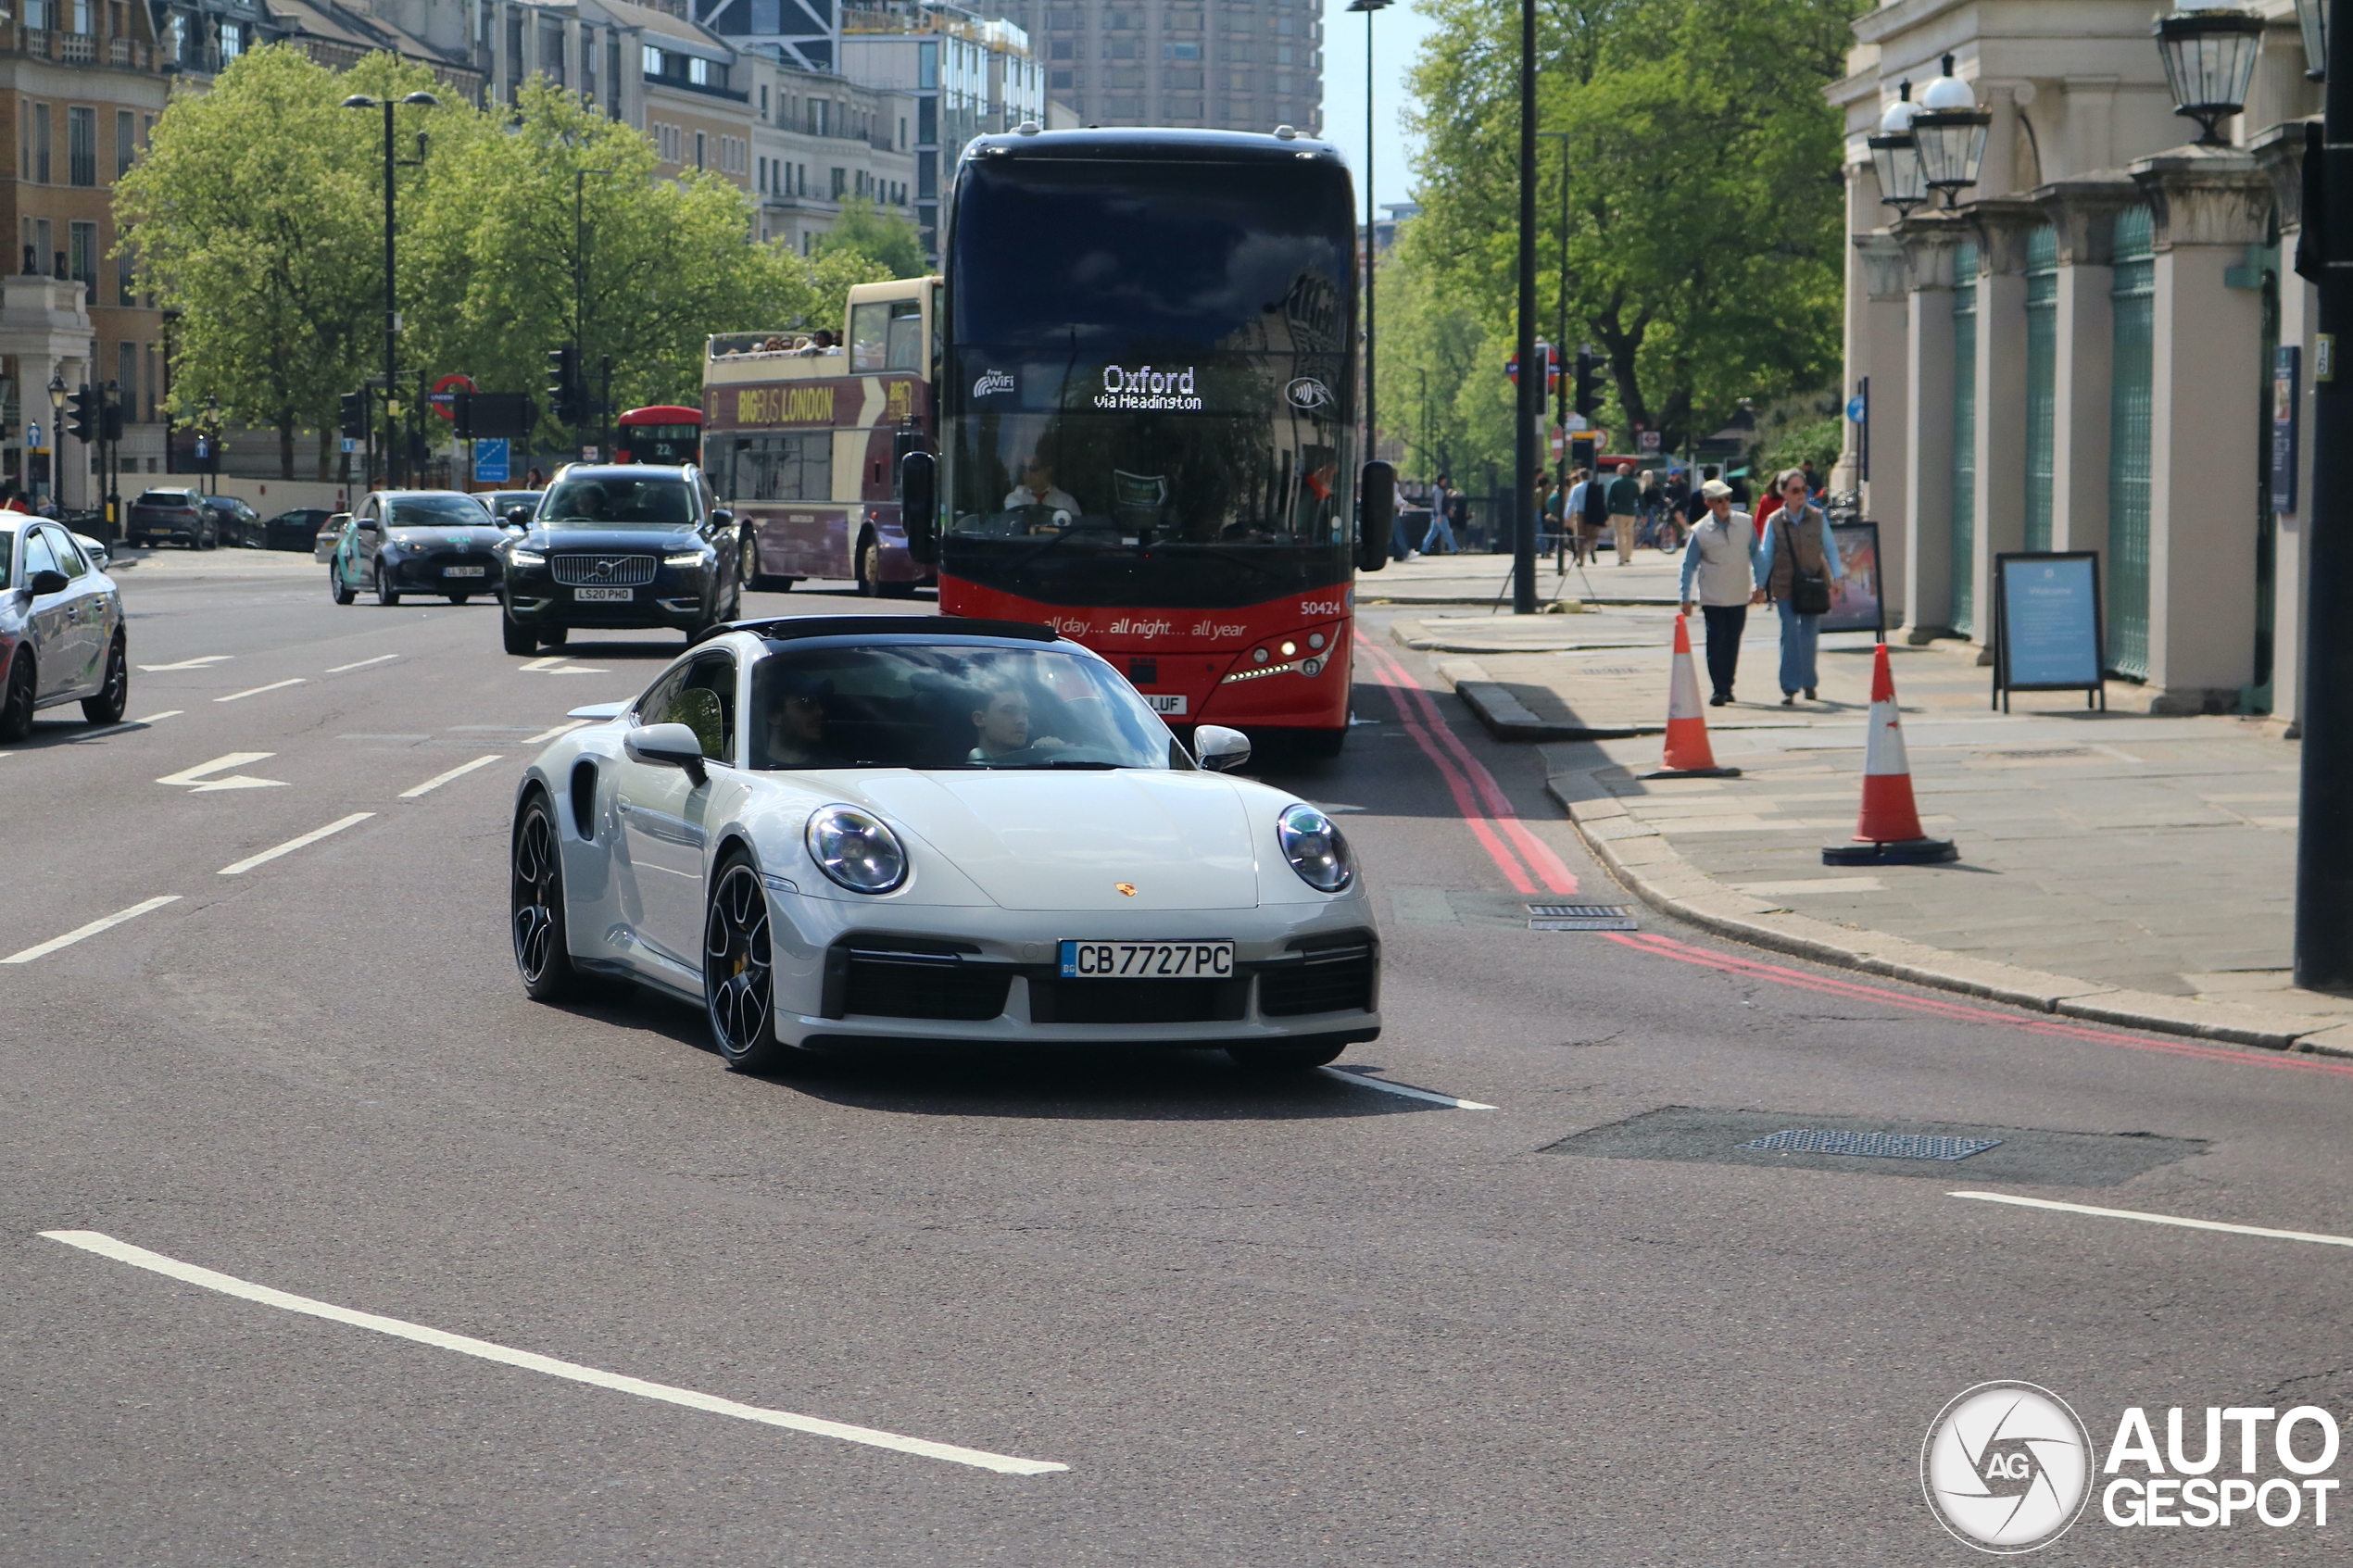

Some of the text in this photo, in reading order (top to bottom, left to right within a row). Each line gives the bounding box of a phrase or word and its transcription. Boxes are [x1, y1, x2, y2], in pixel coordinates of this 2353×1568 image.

[987, 375, 1013, 386] WiFi
[1103, 365, 1194, 394] Oxford
[782, 387, 834, 421] LONDON
[1094, 394, 1202, 409] via Headington
[657, 444, 672, 455] 22
[579, 590, 605, 599] LS20
[1301, 602, 1340, 615] 50424
[1110, 619, 1129, 634] all
[1192, 621, 1210, 635] all
[1212, 624, 1247, 640] year
[1150, 697, 1179, 711] LUF
[1063, 964, 1075, 972] BG
